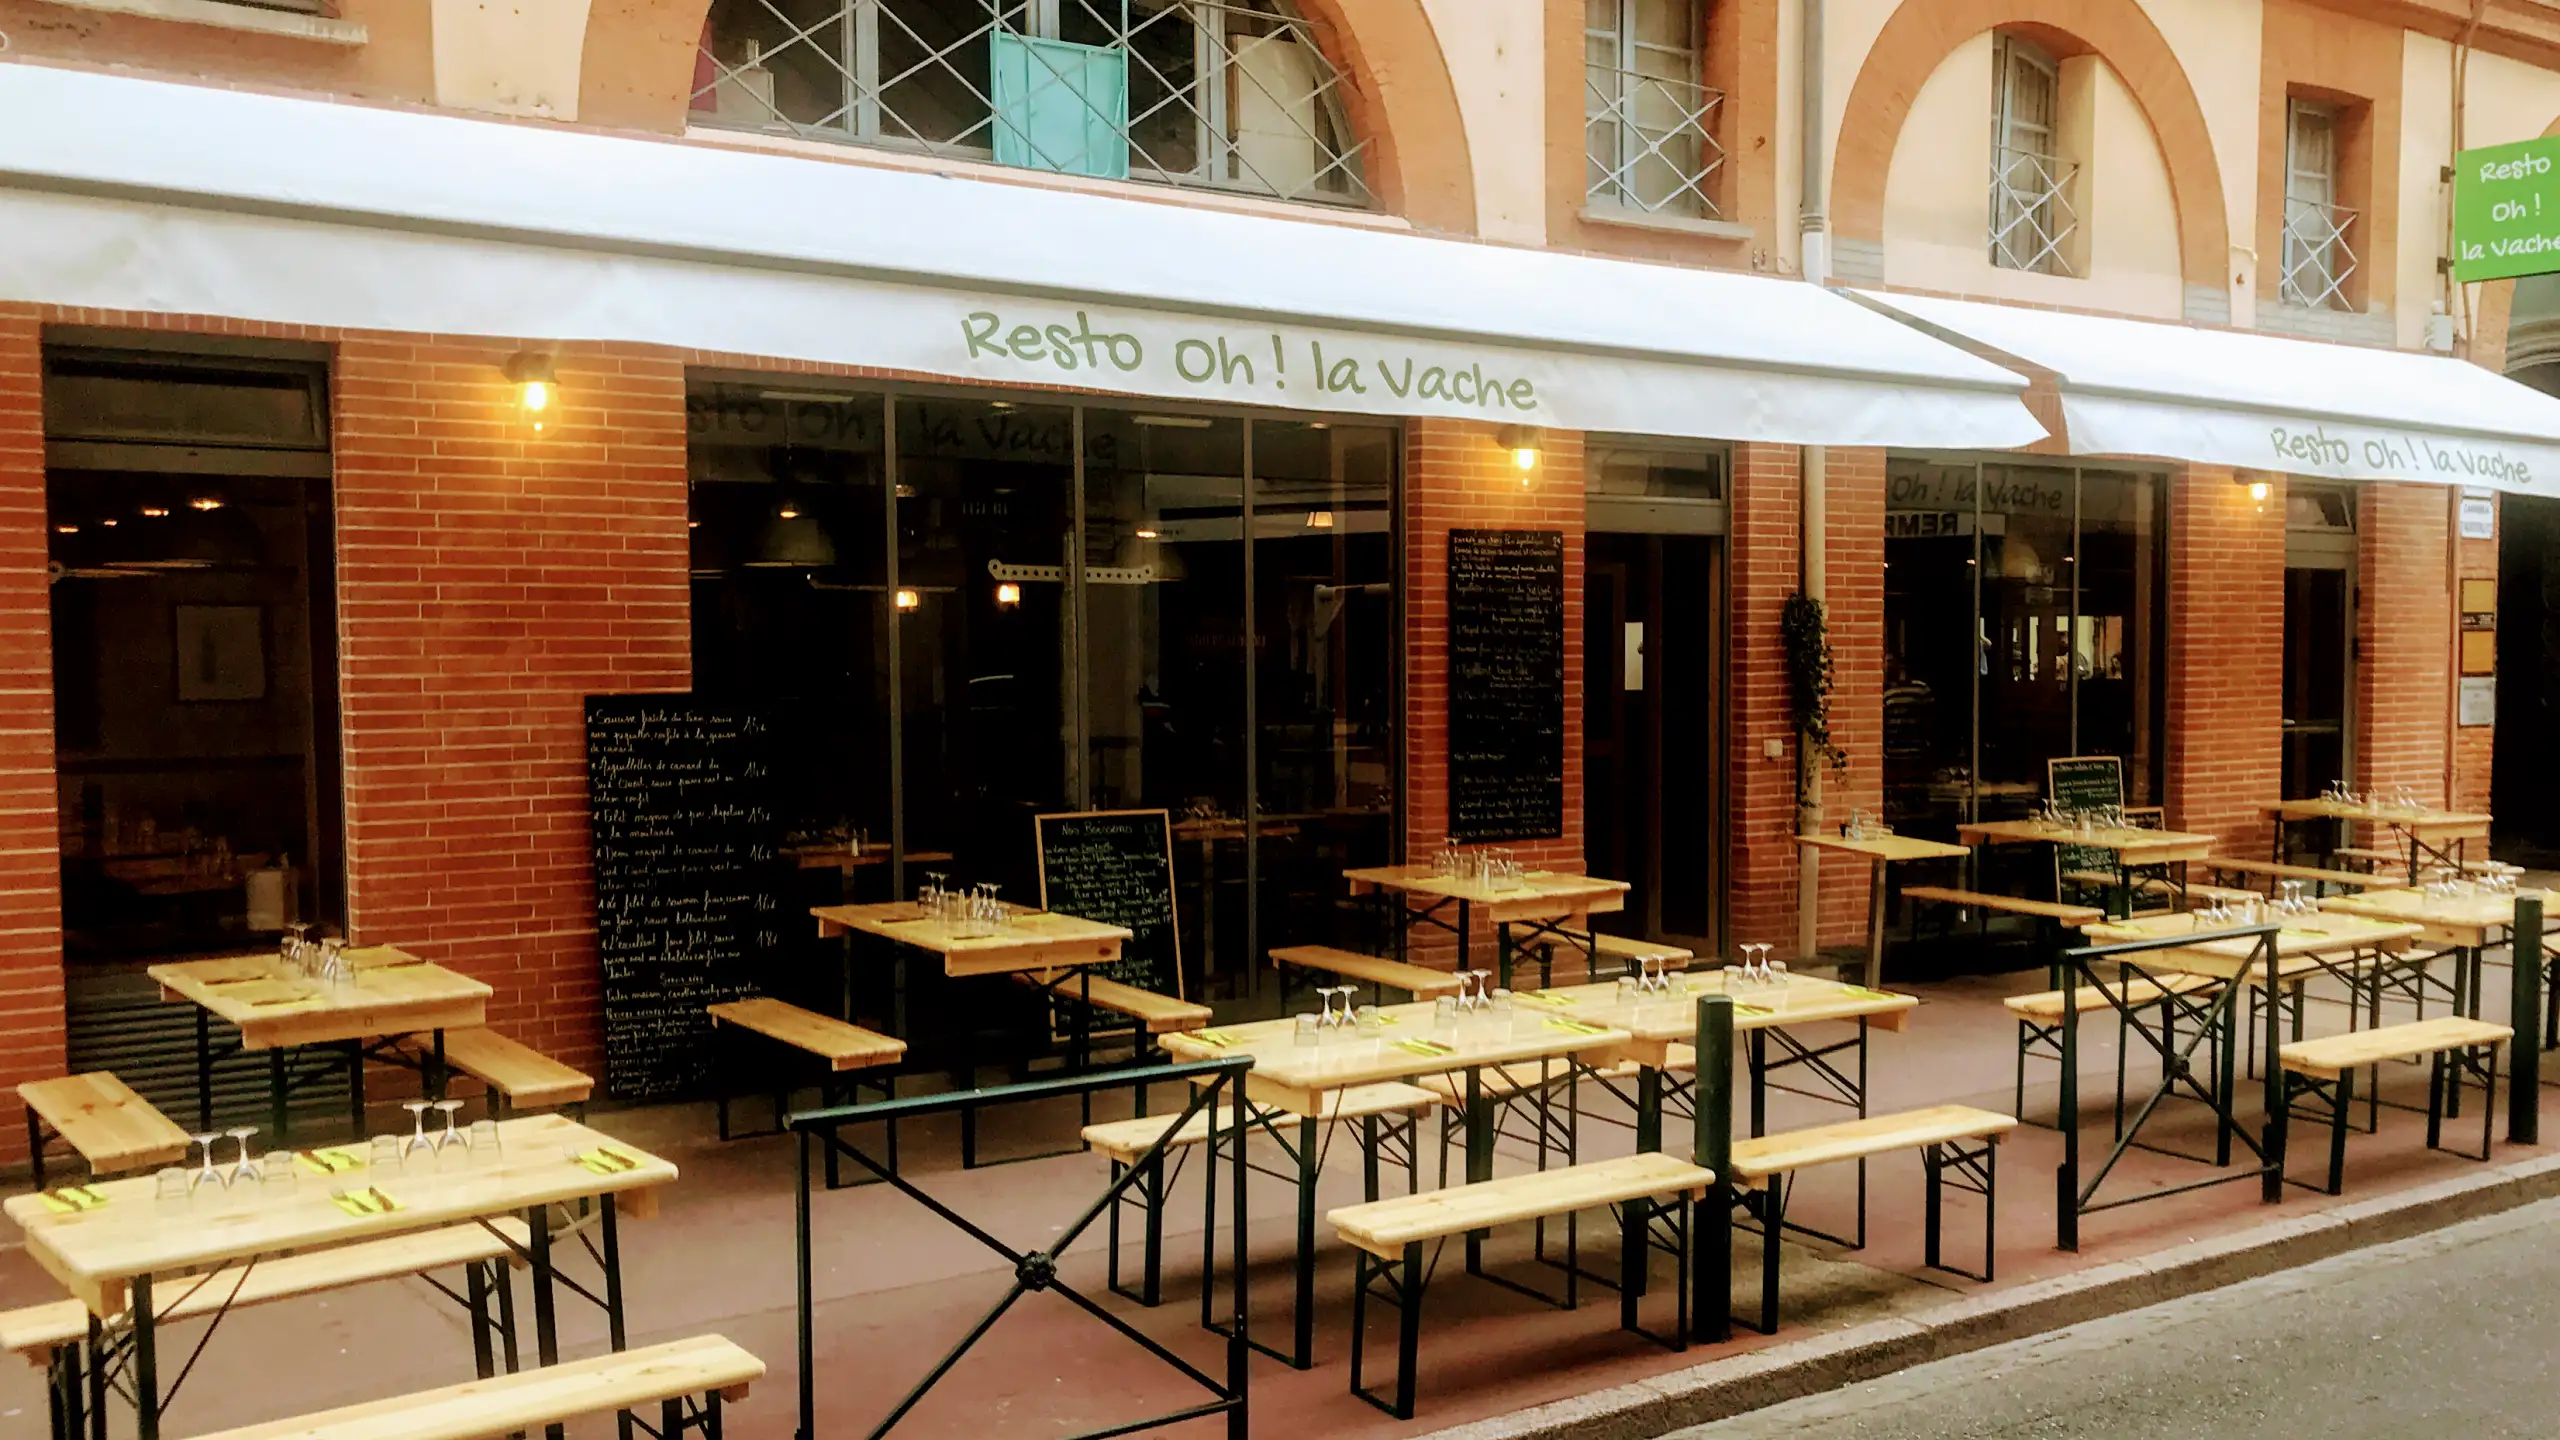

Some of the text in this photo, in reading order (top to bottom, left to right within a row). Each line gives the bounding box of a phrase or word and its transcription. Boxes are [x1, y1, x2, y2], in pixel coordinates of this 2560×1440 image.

[2480, 153, 2551, 183] Resto
[2492, 199, 2526, 222] Oh
[2461, 240, 2485, 260] la
[961, 311, 1142, 371] Resto
[1175, 337, 1254, 385] Oh
[1311, 341, 1367, 394] la
[2270, 426, 2349, 465] Resto
[2364, 439, 2405, 469] Oh
[2423, 440, 2456, 473] la
